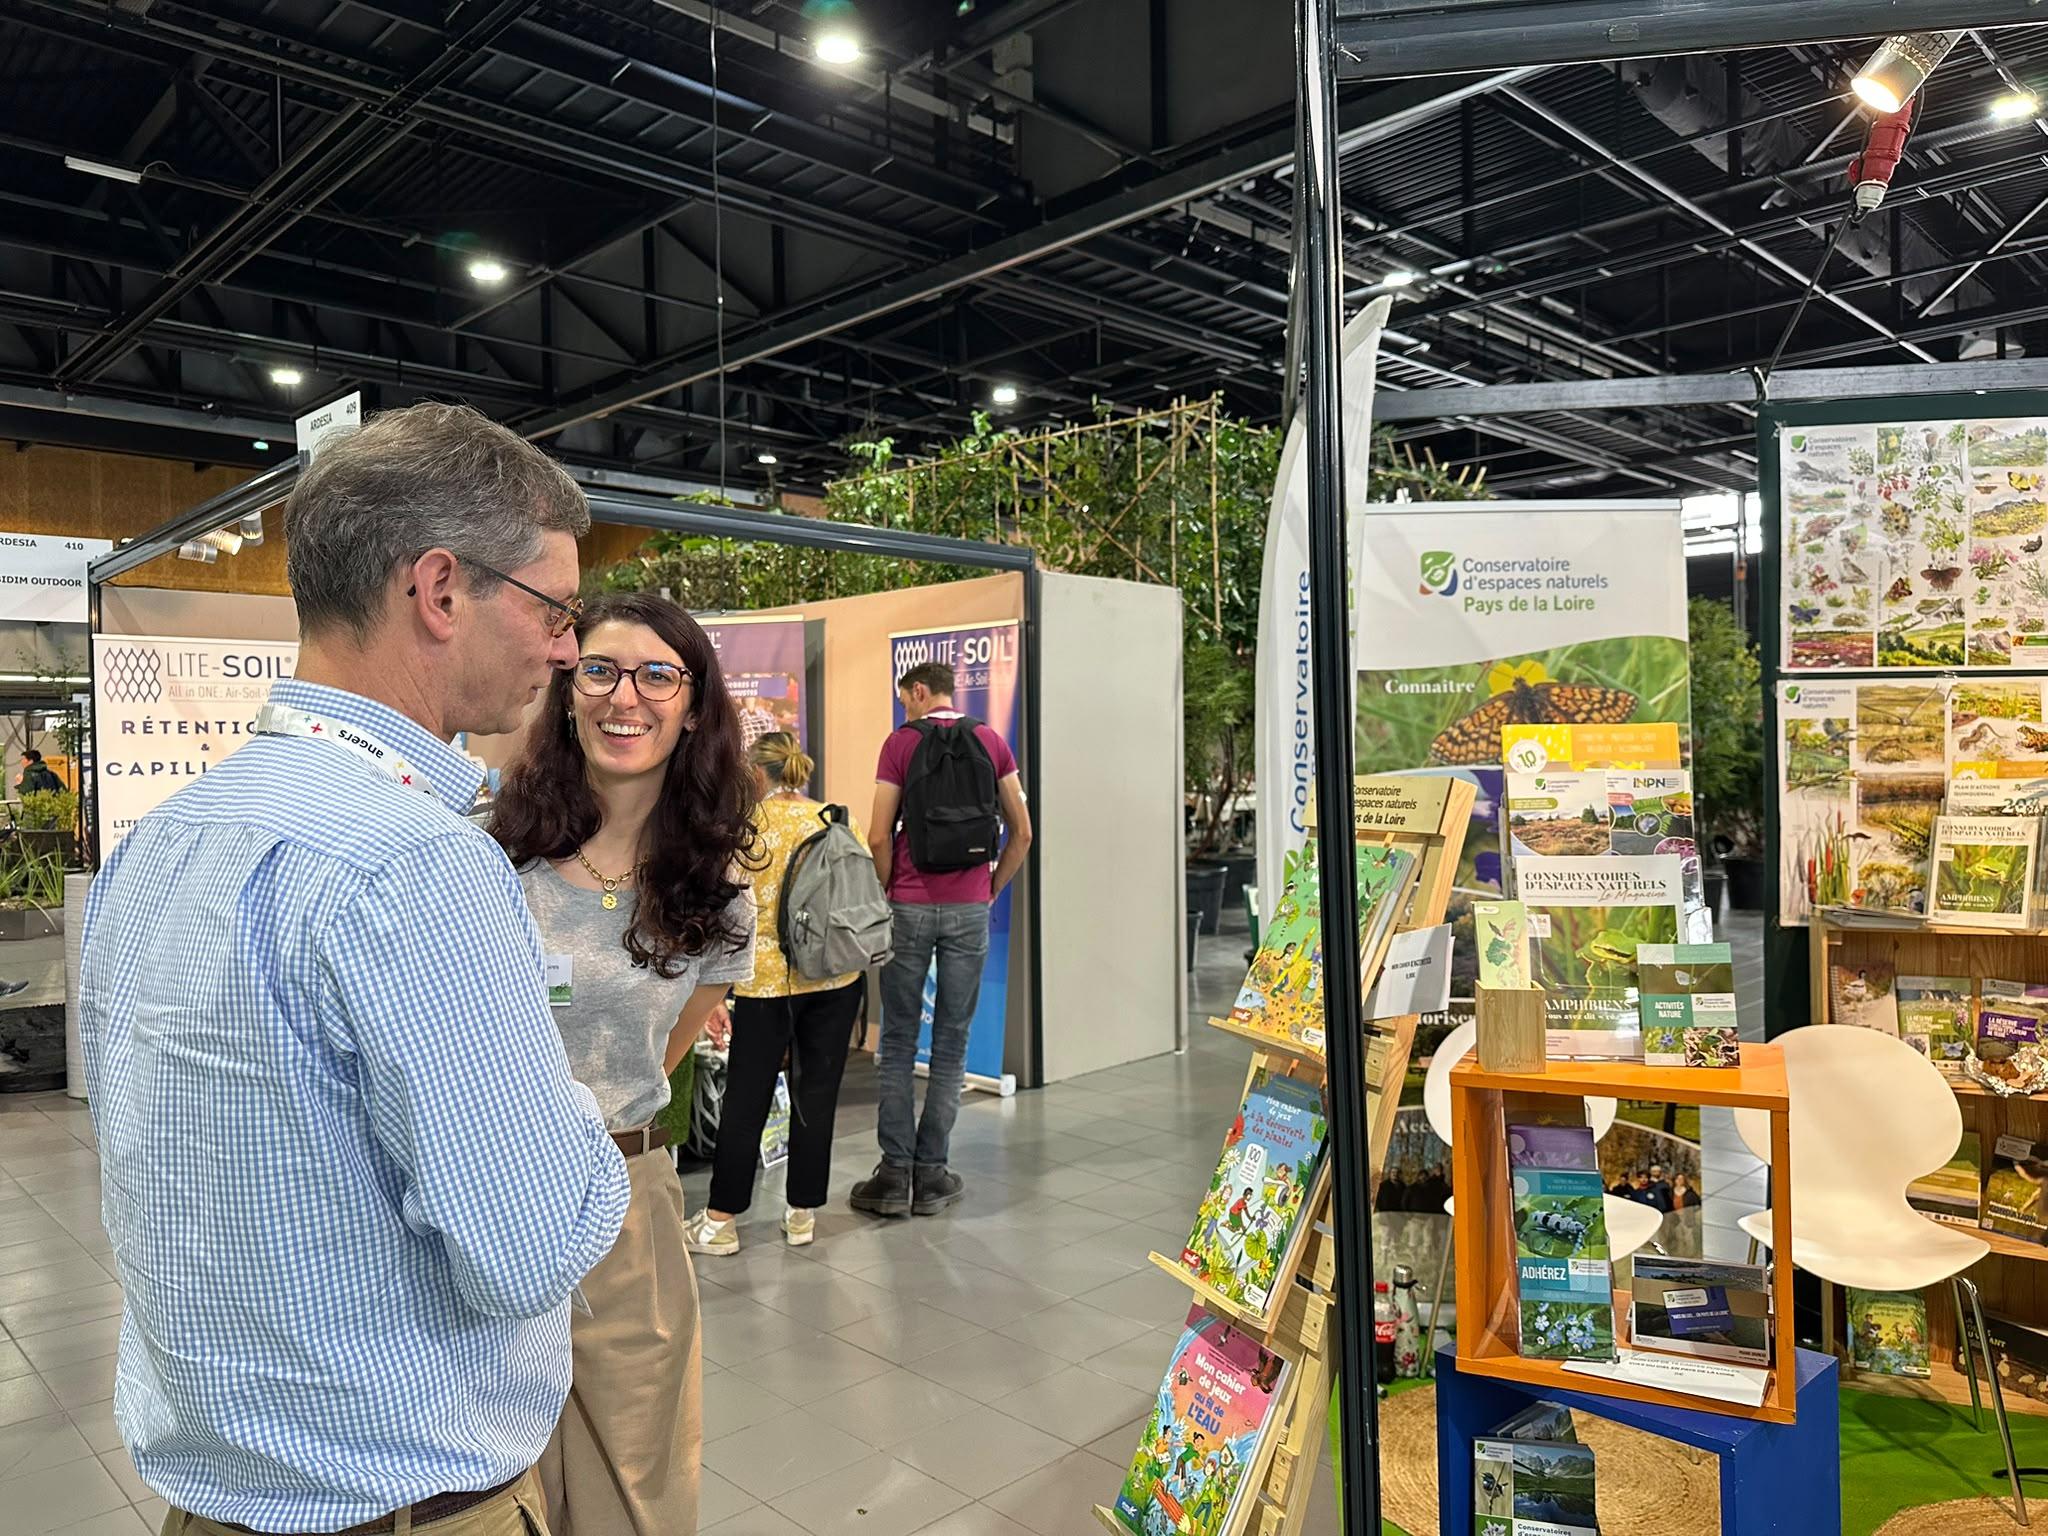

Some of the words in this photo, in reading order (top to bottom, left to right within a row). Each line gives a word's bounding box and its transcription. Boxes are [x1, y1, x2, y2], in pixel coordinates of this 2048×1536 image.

[64, 542, 84, 551] 410
[1463, 557, 1571, 573] Conservatoire
[31, 577, 82, 587] OUTDOOR
[1463, 575, 1542, 592] d'espaces
[1546, 574, 1609, 589] naturels
[1464, 597, 1503, 615] Pays
[1509, 597, 1529, 612] de
[1533, 596, 1548, 612] la
[1553, 595, 1596, 612] Loire
[168, 687, 183, 698] All
[185, 687, 195, 698] in
[225, 687, 270, 699] Air-Soil-
[1290, 569, 1312, 834] Conservatoire
[201, 743, 210, 751] &
[338, 729, 384, 759] angers
[1633, 777, 1666, 788] INPN
[1385, 799, 1417, 809] naturels
[1363, 813, 1373, 823] de
[1375, 813, 1382, 824] la
[1384, 813, 1406, 825] Loire
[1525, 872, 1641, 881] CONSERVATOIRES
[1525, 881, 1594, 890] D'ESPACES
[1596, 880, 1667, 890] NATURELS
[1545, 999, 1633, 1011] AMPHIBIENS
[1655, 1001, 1685, 1010] ACTIVITÉS
[1658, 1010, 1682, 1018] NATURE
[1521, 1265, 1567, 1281] ADHÉREZ
[1195, 1353, 1215, 1376] Mon
[1215, 1369, 1246, 1396] cahier
[1199, 1375, 1212, 1389] de
[1208, 1381, 1232, 1405] jeux
[1194, 1392, 1205, 1404] au
[1205, 1396, 1215, 1411] fil
[1213, 1405, 1224, 1418] de
[1187, 1402, 1221, 1435] L'EAU
